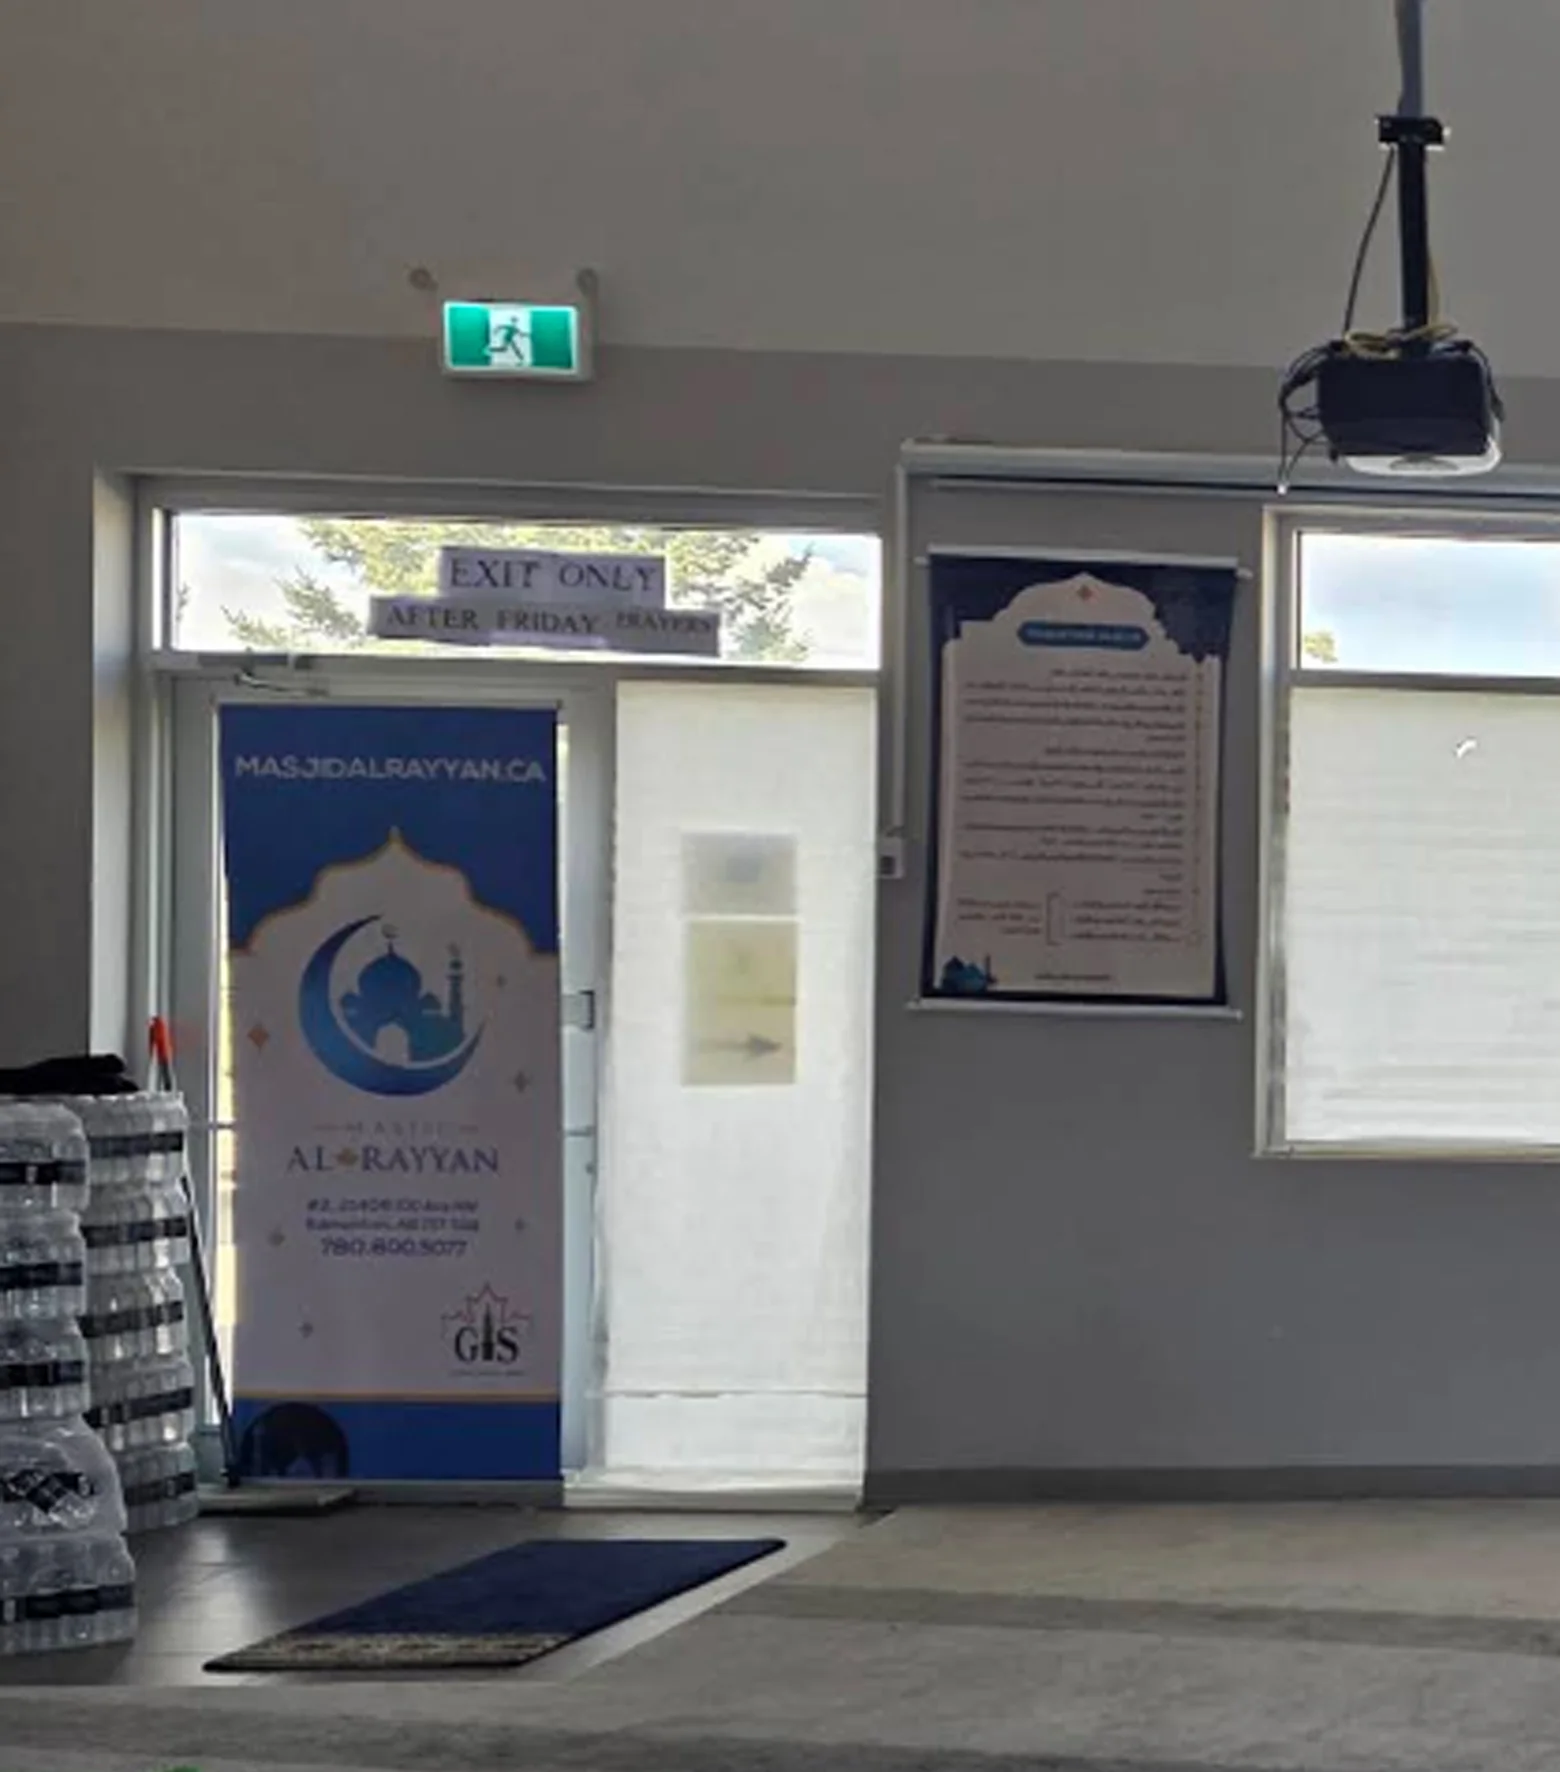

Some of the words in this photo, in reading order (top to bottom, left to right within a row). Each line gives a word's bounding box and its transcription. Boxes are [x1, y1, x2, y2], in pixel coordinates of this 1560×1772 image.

[450, 559, 540, 589] EXIT
[559, 563, 656, 592] ONLY
[387, 605, 480, 630] AFTER
[500, 609, 599, 634] FRIDAY
[235, 755, 546, 783] MASJIDALRAYYAN.CA
[286, 1145, 335, 1173] AL
[361, 1145, 501, 1177] RAYYAN
